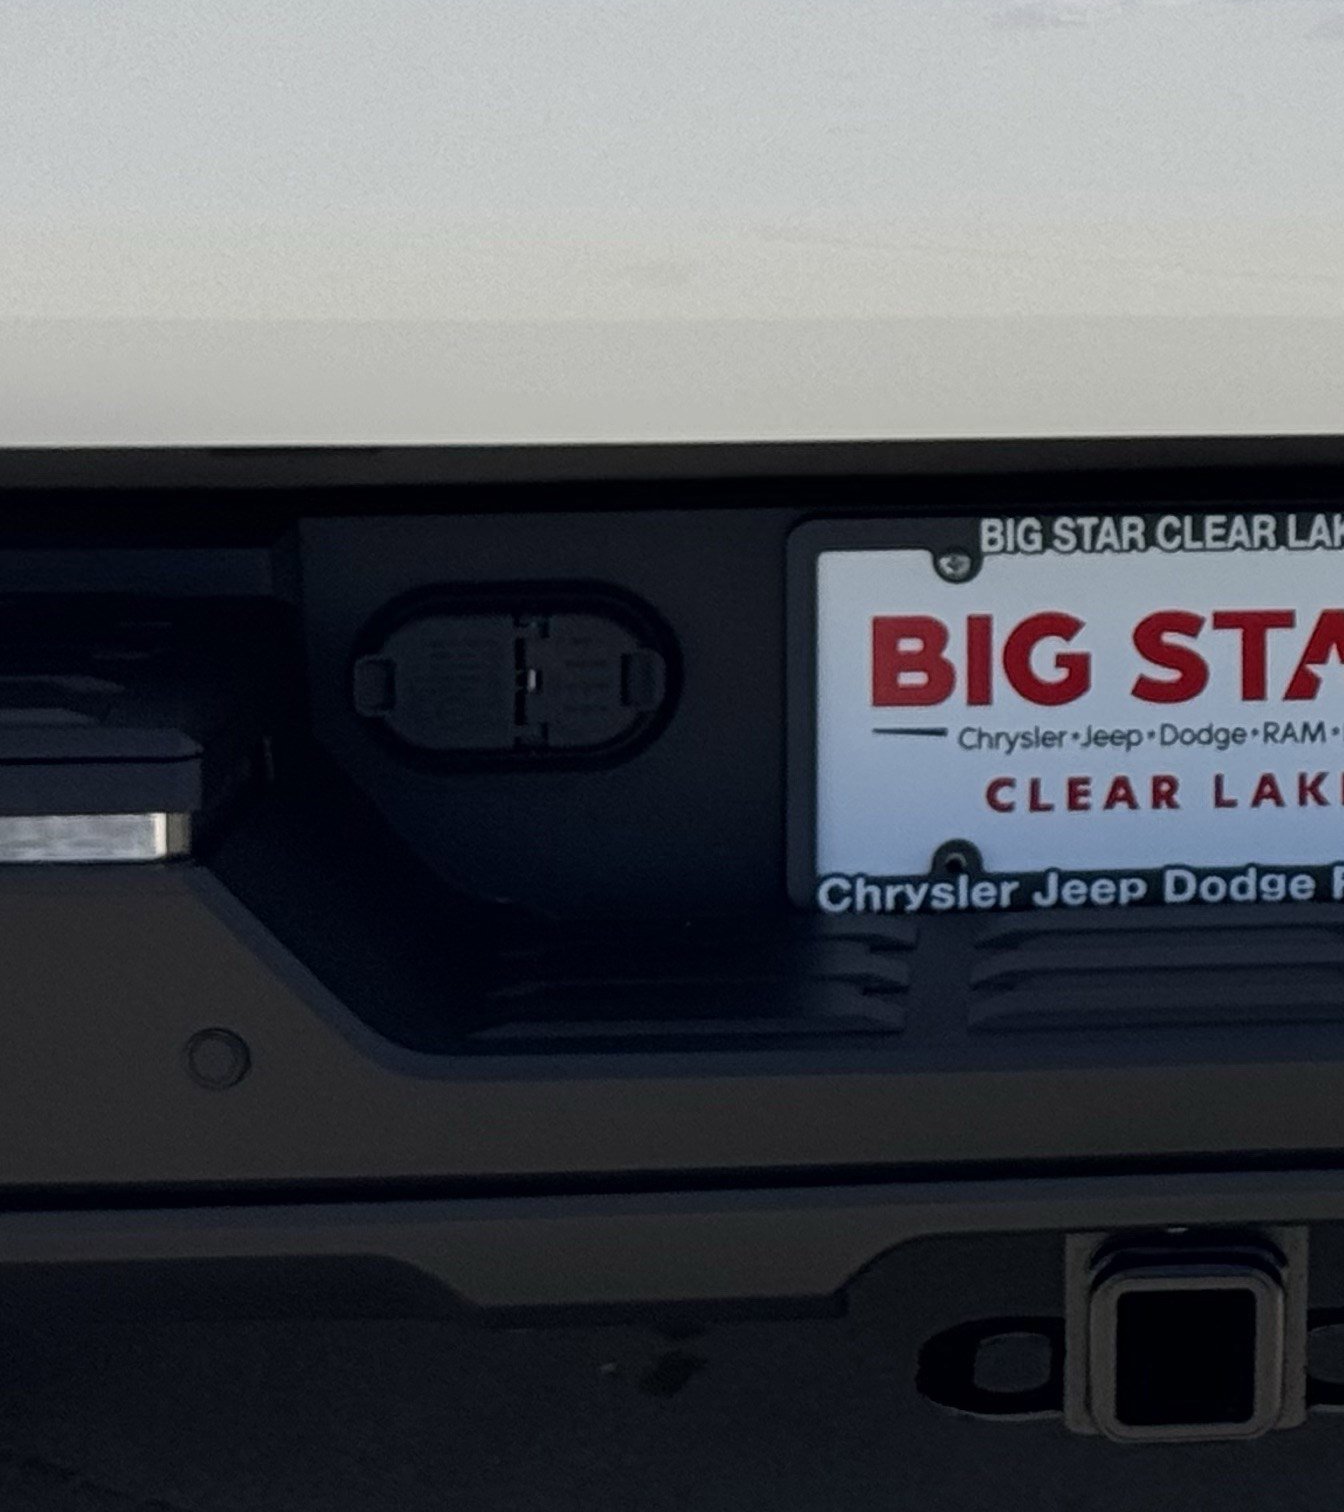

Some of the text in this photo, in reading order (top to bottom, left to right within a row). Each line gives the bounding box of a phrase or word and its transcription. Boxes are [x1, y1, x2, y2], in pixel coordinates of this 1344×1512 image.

[980, 517, 1043, 555] BIG
[1053, 516, 1145, 552] STAR
[1155, 515, 1278, 551] CLEAR
[870, 611, 1092, 707] BIG
[957, 724, 1067, 753] Chrysler
[1080, 723, 1143, 752] Jeep
[1160, 721, 1248, 750] Dodge
[1263, 720, 1328, 745] RAM
[985, 774, 1181, 813] CLEAR
[816, 871, 1020, 915] Chrysler
[1032, 869, 1148, 911] Jeep
[1162, 865, 1317, 903] Dodge
